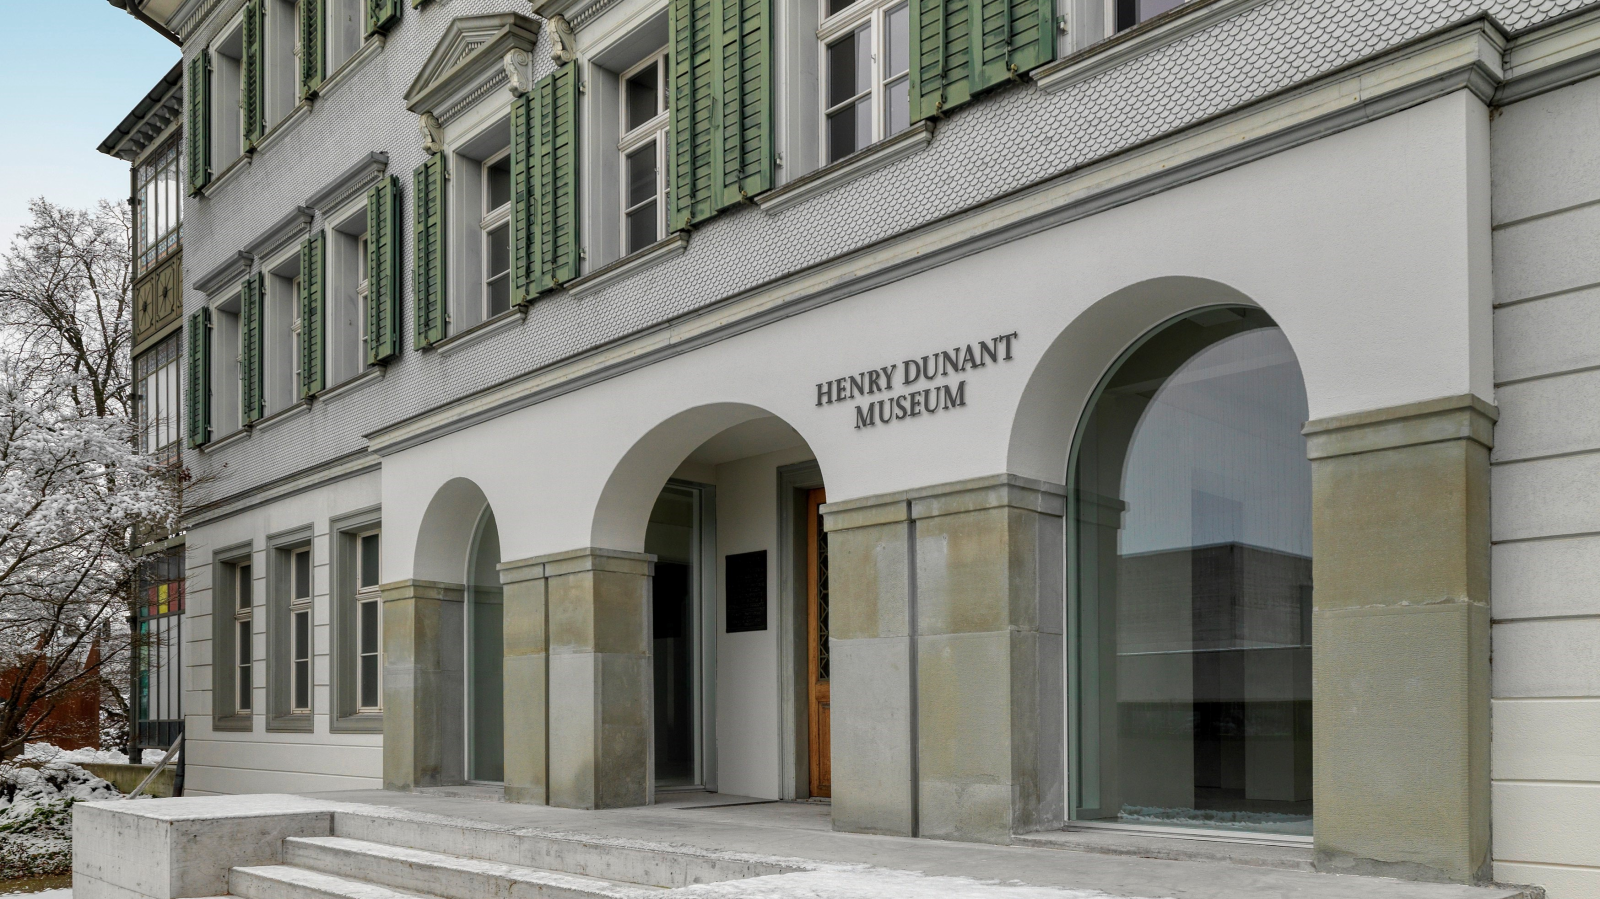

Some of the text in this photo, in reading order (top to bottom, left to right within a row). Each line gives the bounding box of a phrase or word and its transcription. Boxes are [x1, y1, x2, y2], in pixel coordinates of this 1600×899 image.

[815, 331, 1018, 407] HENRY DUNANT
[854, 380, 967, 430] MUSEUM
